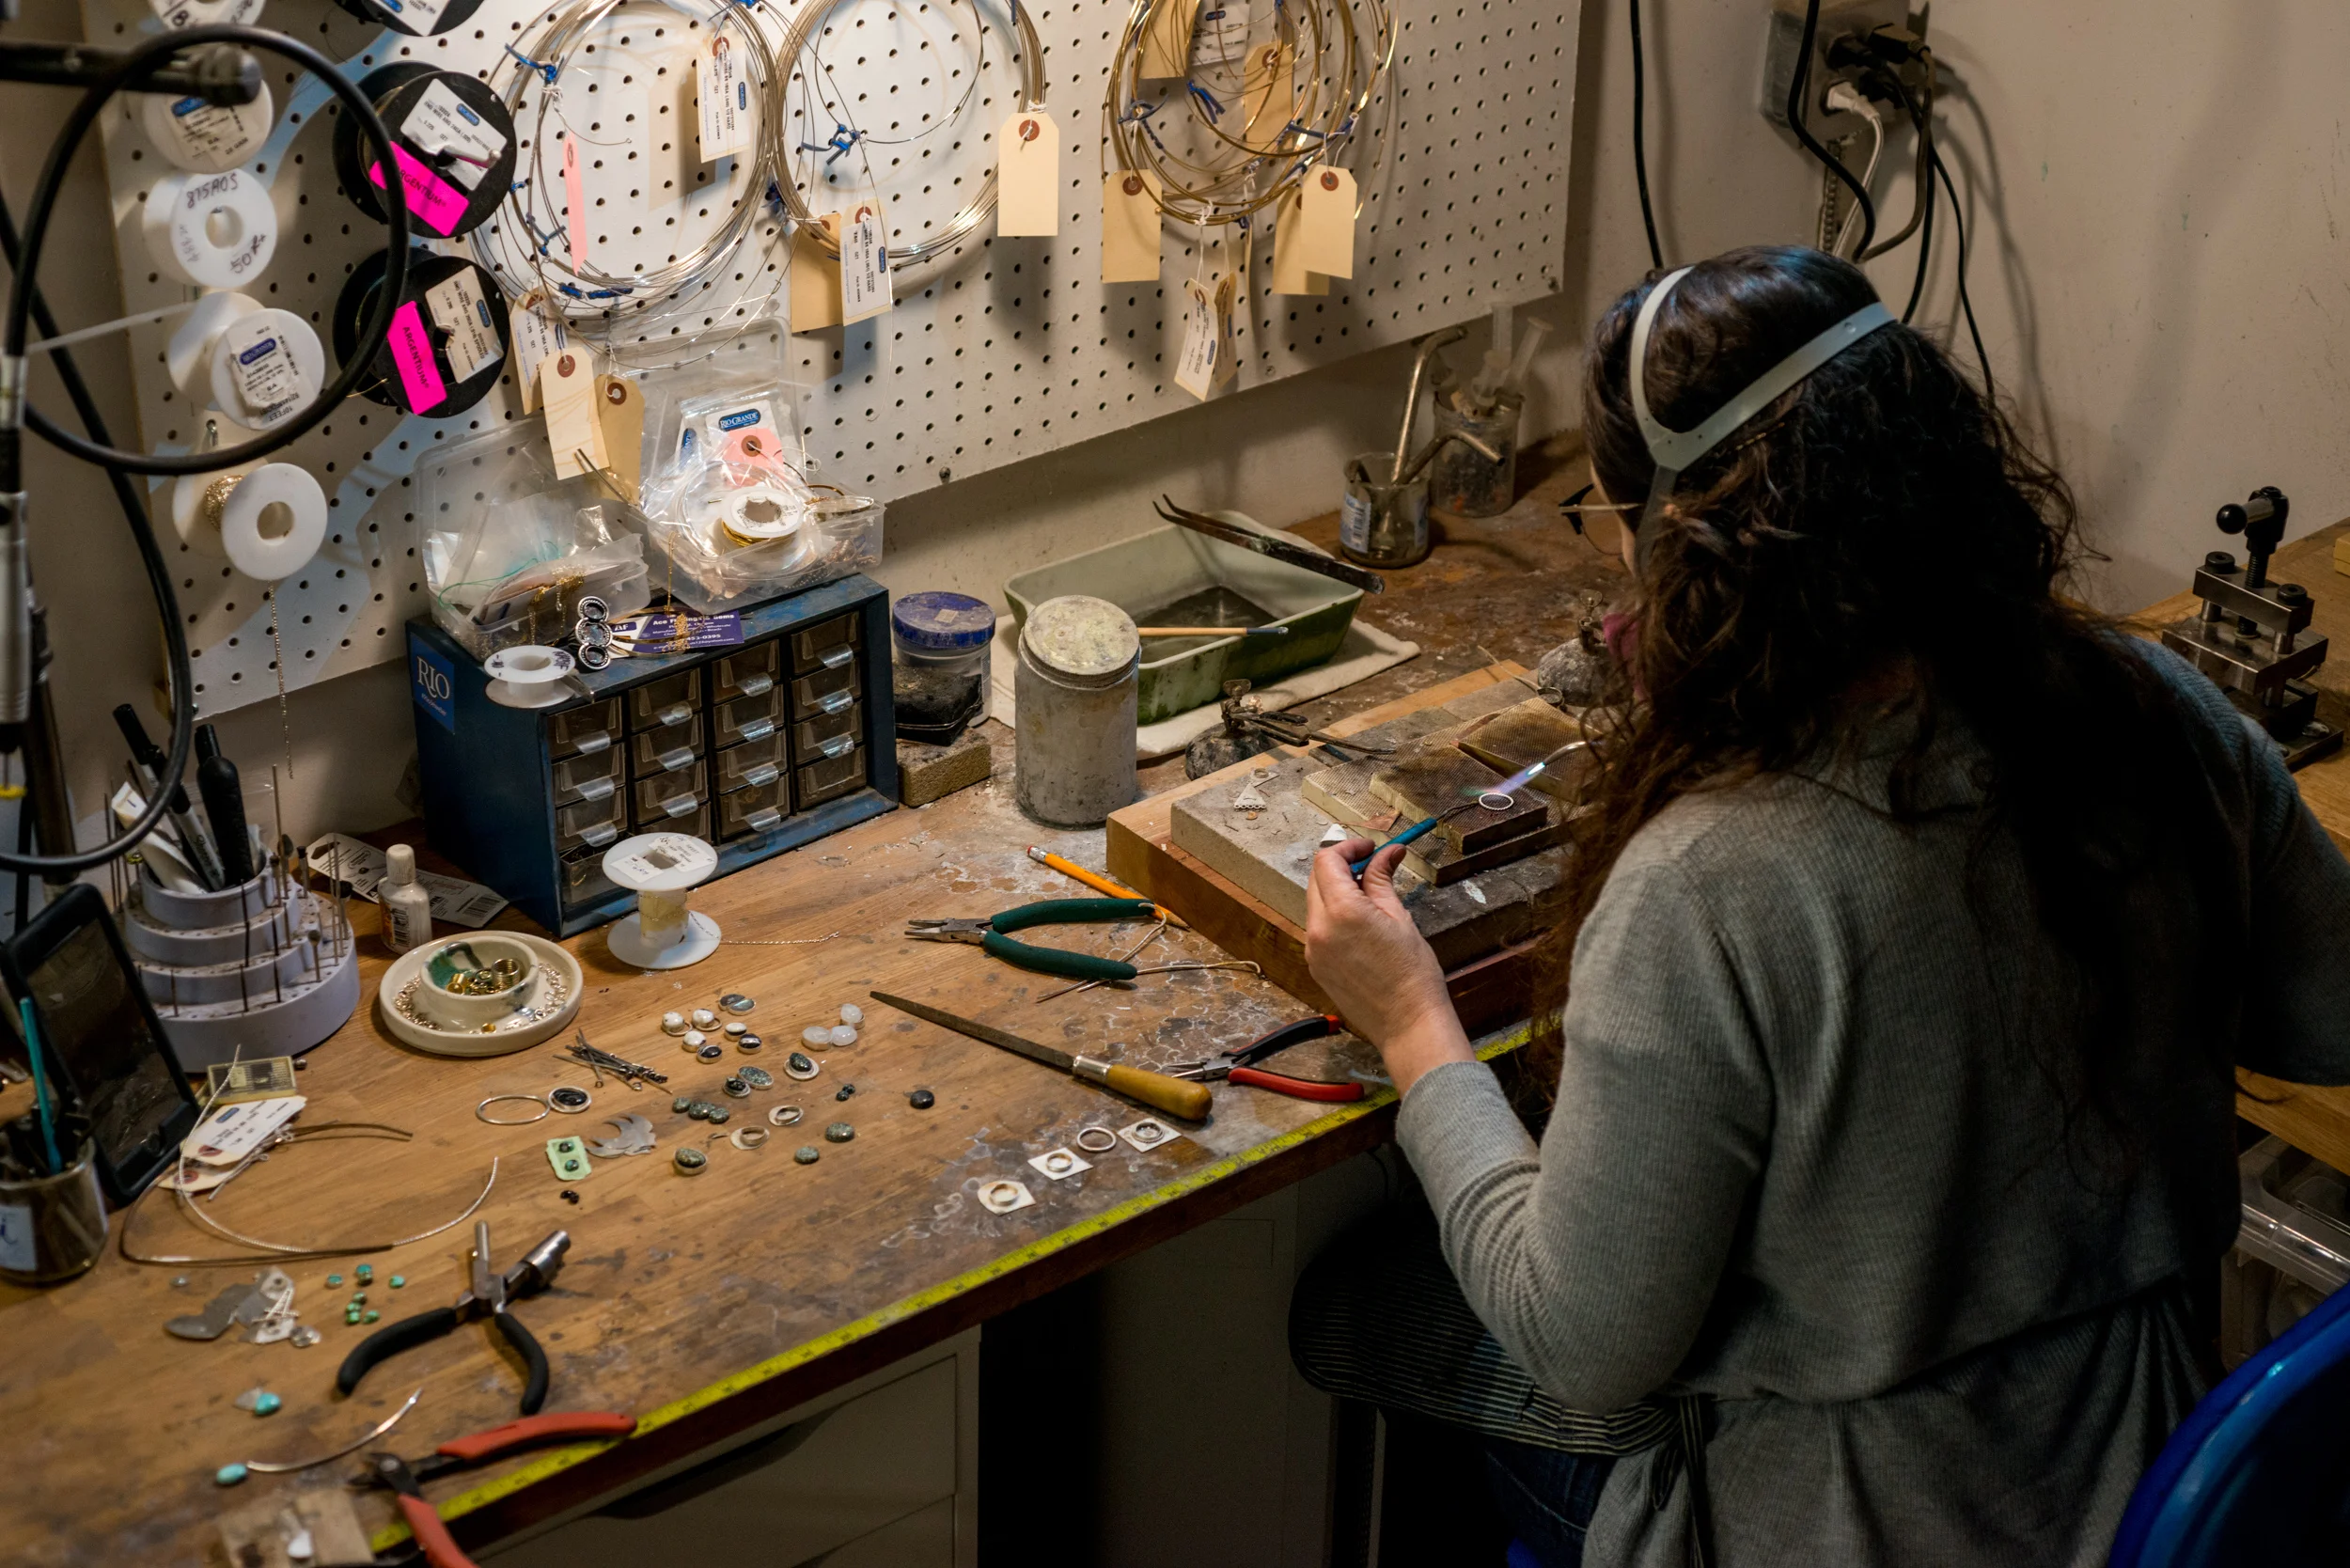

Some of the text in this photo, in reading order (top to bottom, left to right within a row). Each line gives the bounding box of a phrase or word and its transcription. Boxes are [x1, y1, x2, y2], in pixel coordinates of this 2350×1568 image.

[720, 412, 758, 428] RIO GRANDE
[417, 656, 450, 699] RIO
